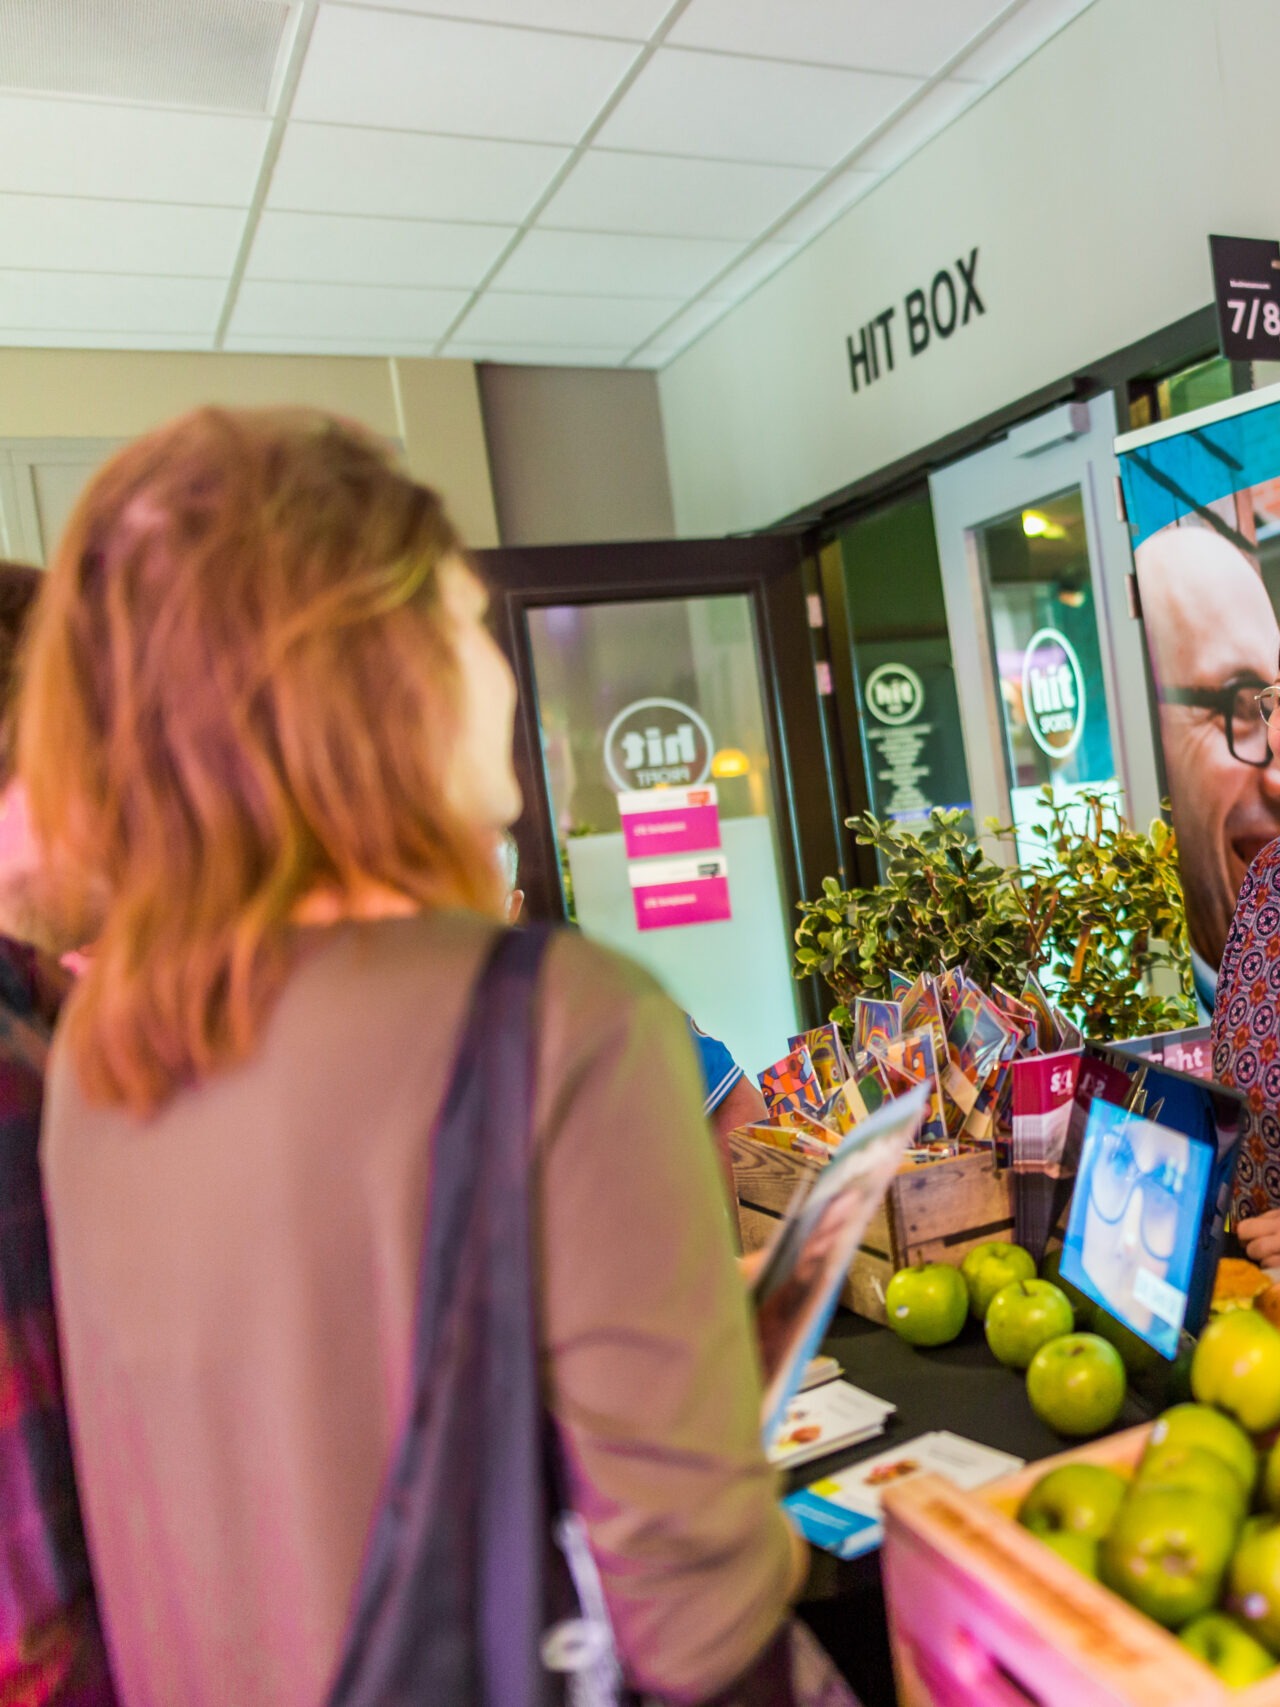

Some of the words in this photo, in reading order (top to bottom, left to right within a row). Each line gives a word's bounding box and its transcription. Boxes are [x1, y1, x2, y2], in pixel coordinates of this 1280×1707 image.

[846, 305, 895, 394] HIT
[904, 246, 986, 358] BOX
[1029, 663, 1076, 714] hit
